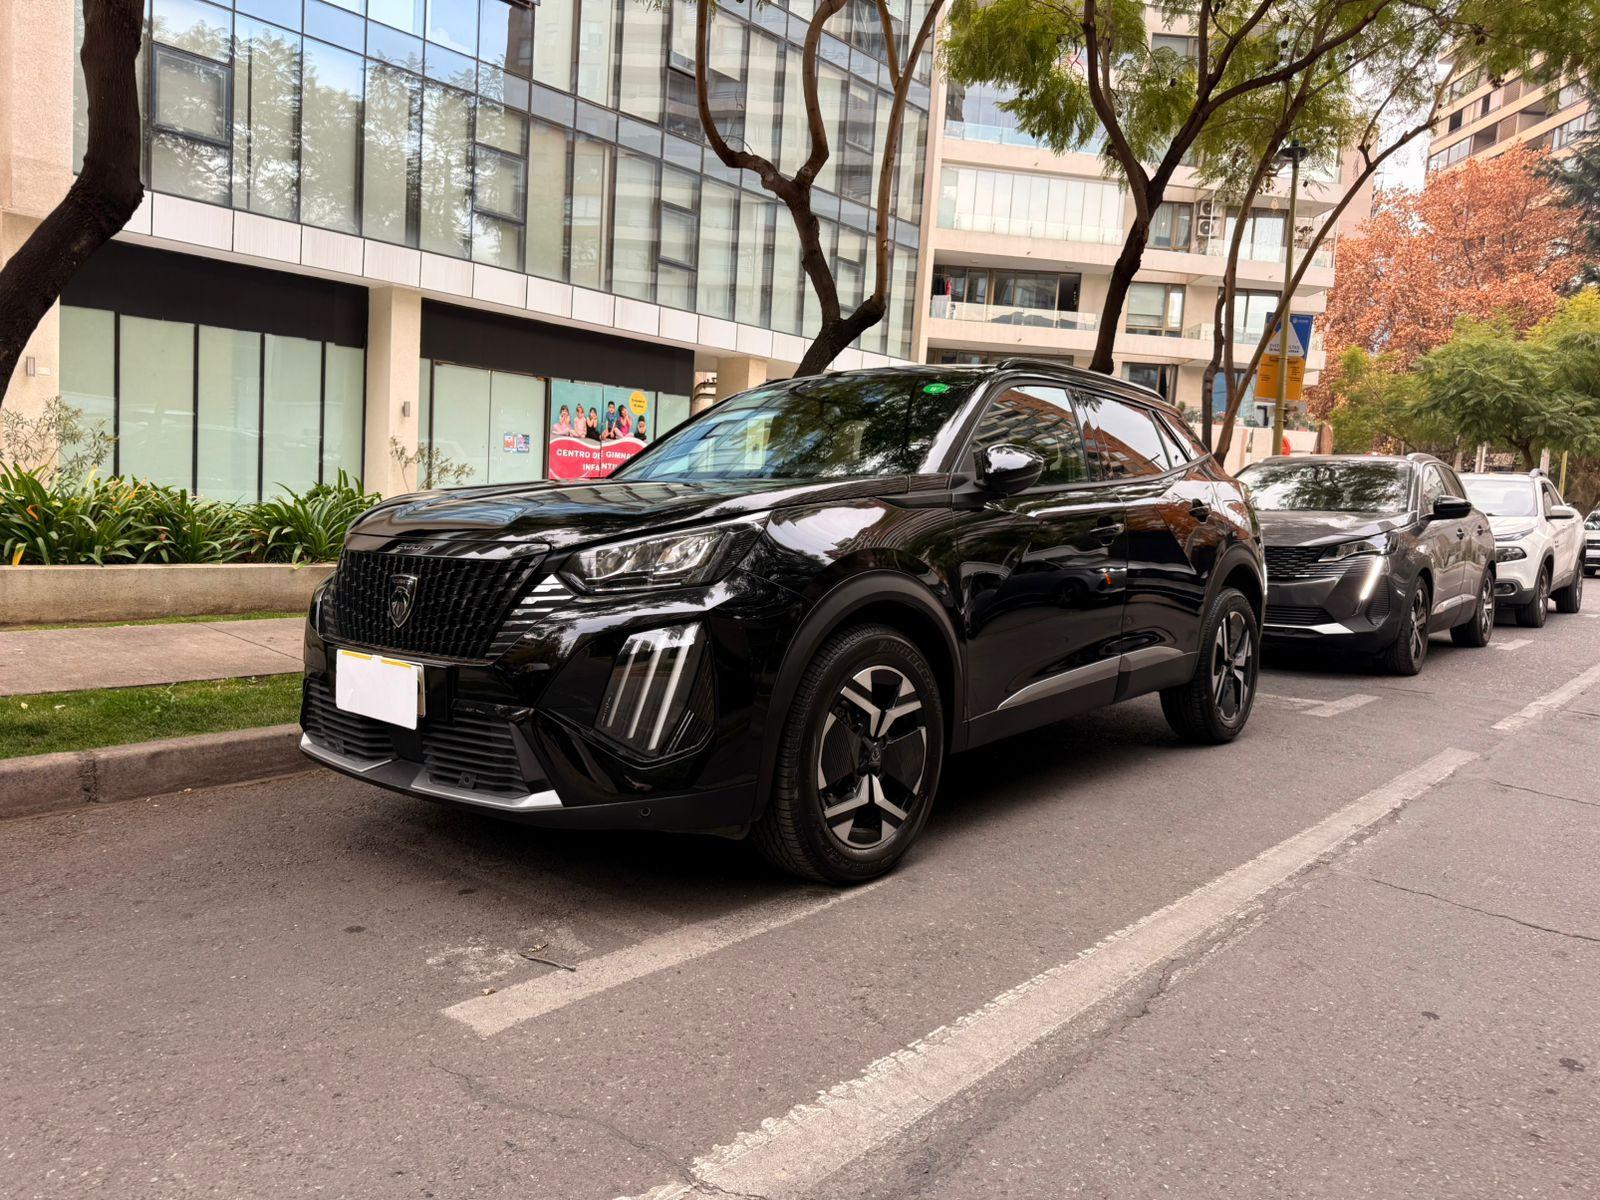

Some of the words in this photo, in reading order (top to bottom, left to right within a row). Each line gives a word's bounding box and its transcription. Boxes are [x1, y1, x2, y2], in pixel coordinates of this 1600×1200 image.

[556, 449, 590, 458] CENTRO
[592, 451, 604, 459] DE
[606, 451, 636, 460] GIMNA
